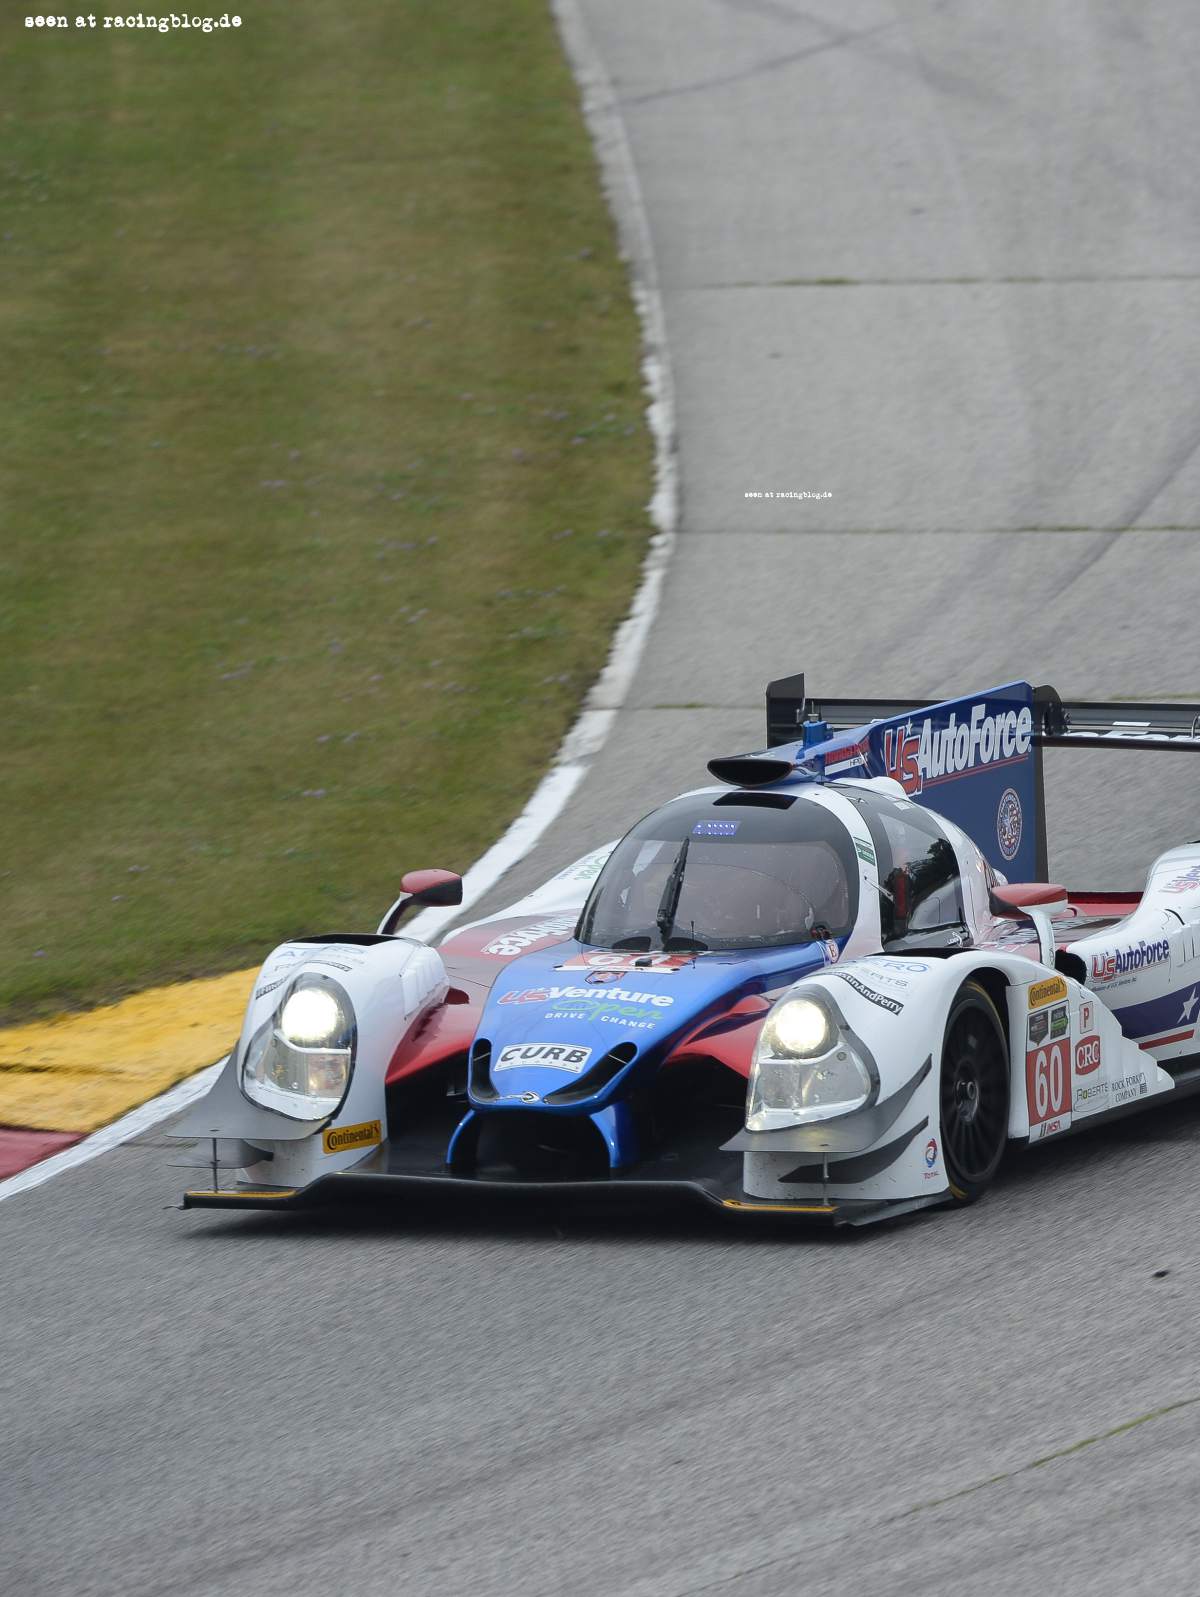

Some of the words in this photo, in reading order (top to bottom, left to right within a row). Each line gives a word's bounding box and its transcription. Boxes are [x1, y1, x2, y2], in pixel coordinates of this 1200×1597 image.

[544, 1012, 587, 1020] DRIVE
[600, 1015, 656, 1030] CHANGE
[500, 1046, 588, 1063] CURB
[1076, 1040, 1100, 1069] CRC
[1035, 1045, 1063, 1118] 60
